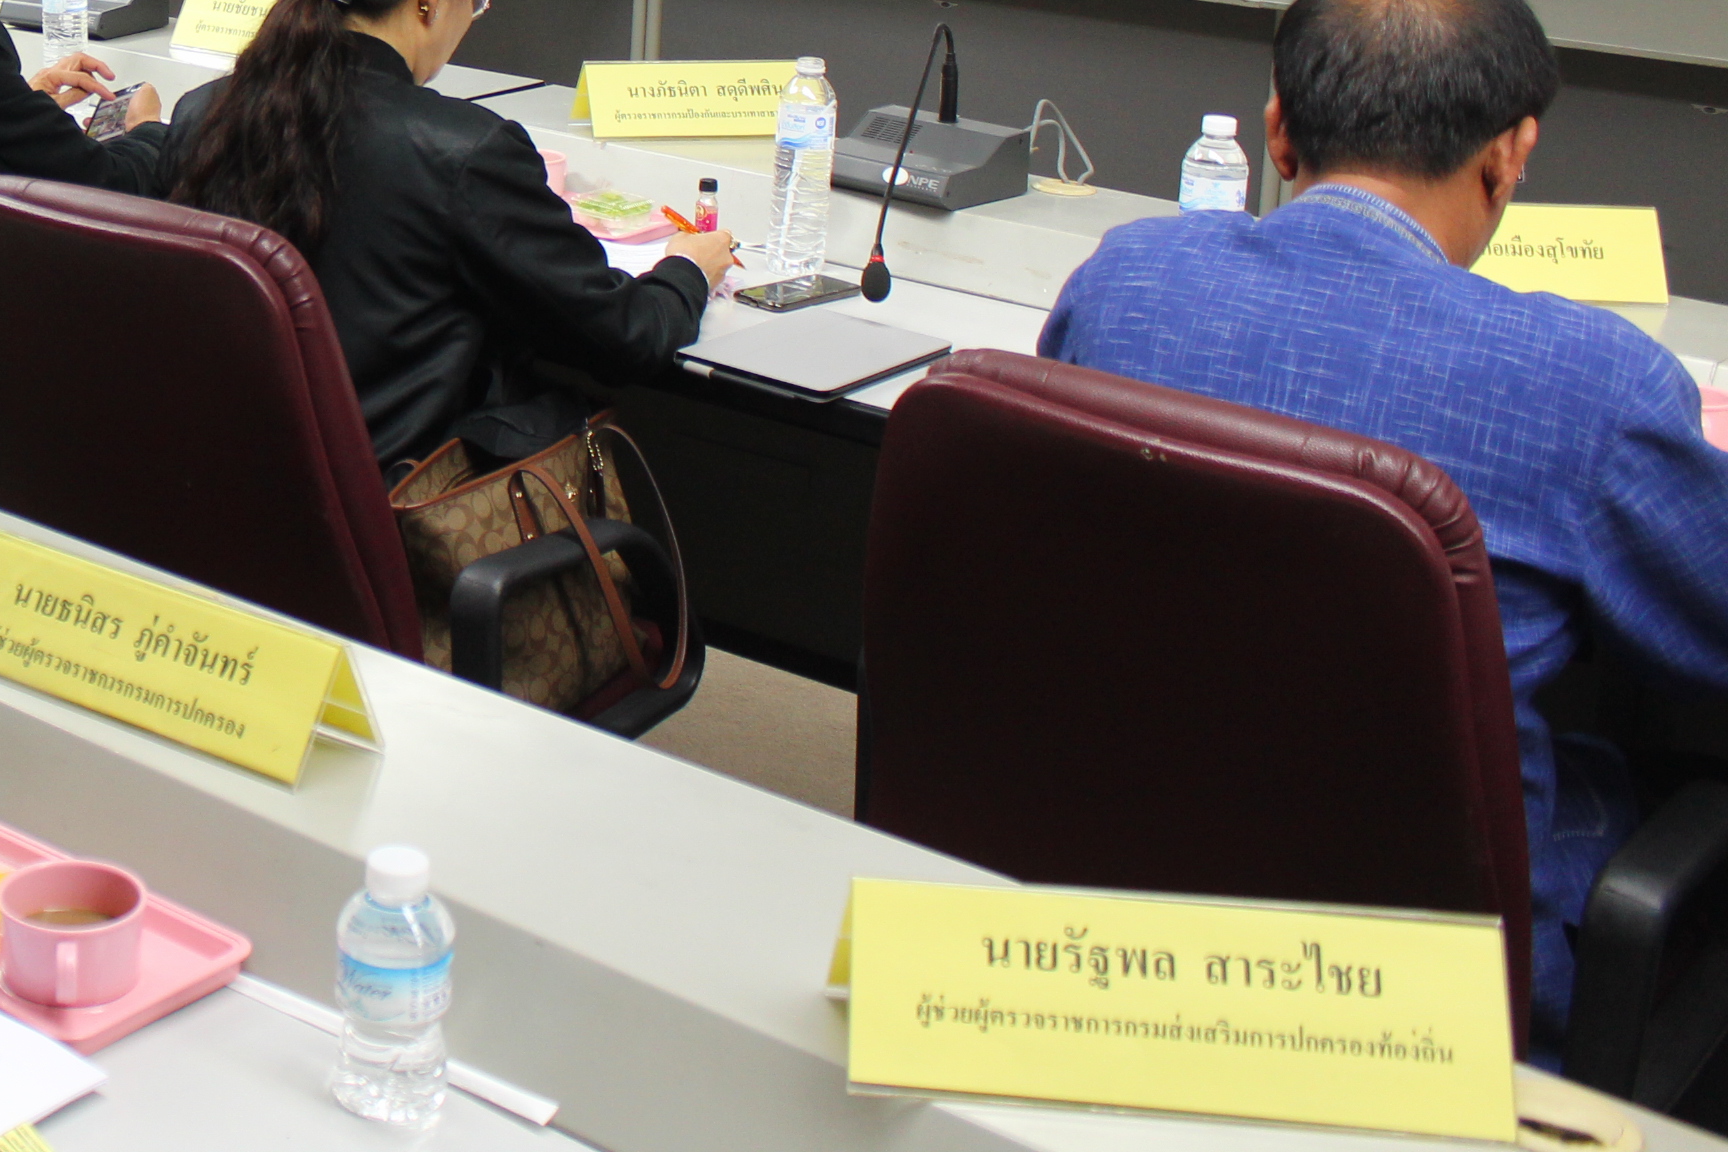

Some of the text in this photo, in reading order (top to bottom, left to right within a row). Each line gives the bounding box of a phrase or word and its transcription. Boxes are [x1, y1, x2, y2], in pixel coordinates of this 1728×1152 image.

[717, 78, 783, 102] สดุดีพศิน
[908, 174, 940, 190] NPE
[14, 583, 260, 686] นายธนิสร ภู่คำจันทร์
[981, 926, 1383, 998] นายรัฐพล สาระไชย
